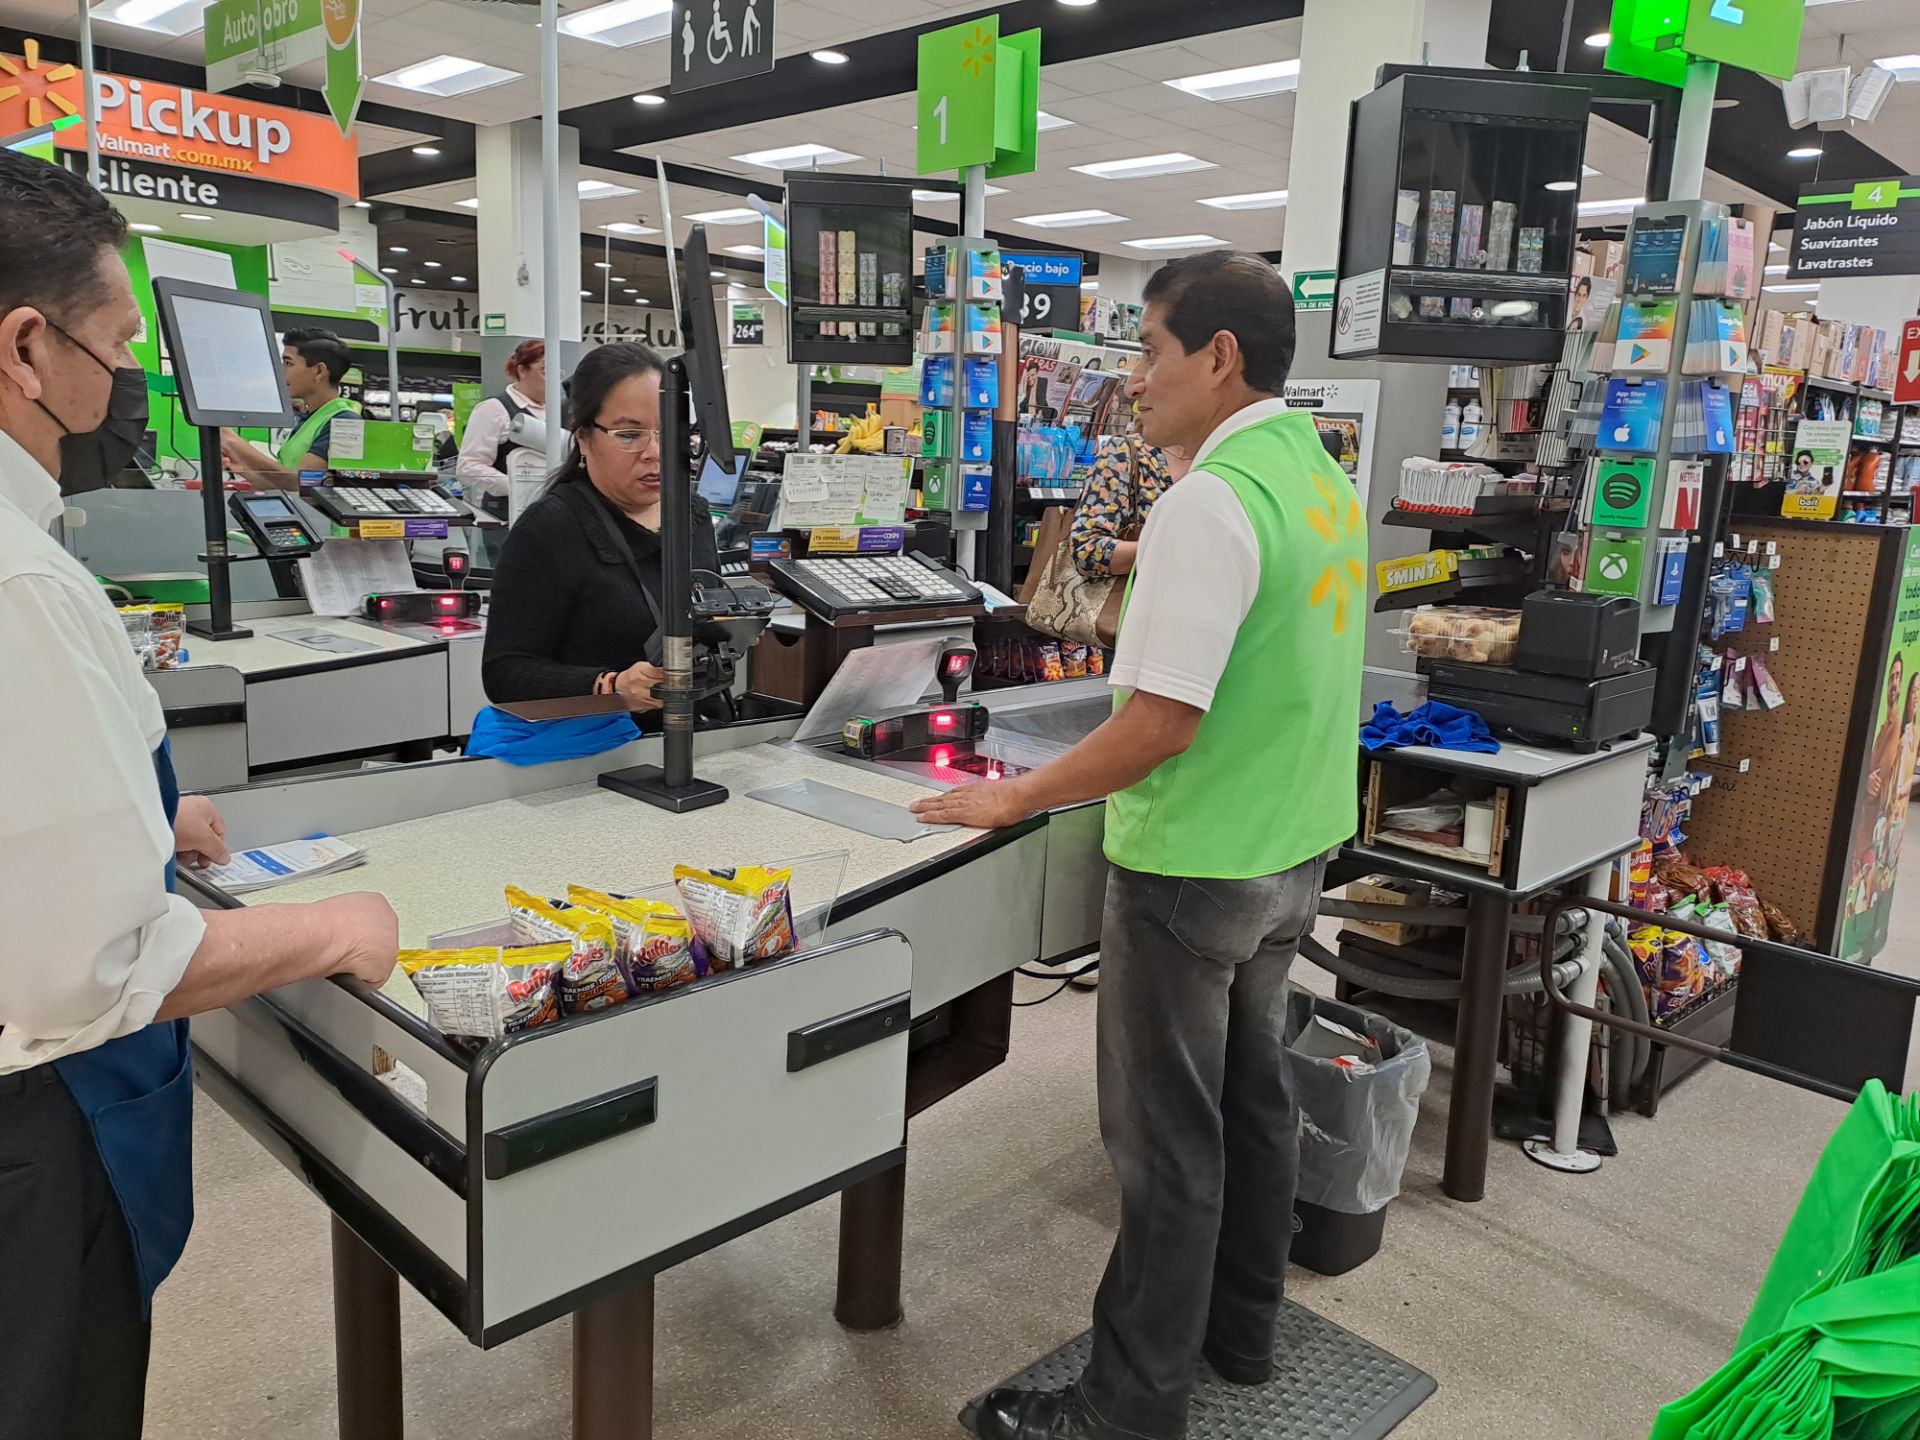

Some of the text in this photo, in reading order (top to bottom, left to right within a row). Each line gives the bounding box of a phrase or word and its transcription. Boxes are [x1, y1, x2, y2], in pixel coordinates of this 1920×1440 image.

[223, 0, 298, 47] Autoobro
[94, 75, 292, 164] Pickup
[932, 96, 948, 145] 1
[87, 160, 219, 206] cliente
[1867, 185, 1883, 203] 4
[1803, 213, 1898, 231] Jabón Líquido
[1800, 236, 1879, 250] Suavizantes
[1045, 262, 1070, 277] bajo
[1797, 257, 1874, 270] Lavatrastes
[1026, 357, 1057, 371] CRAS
